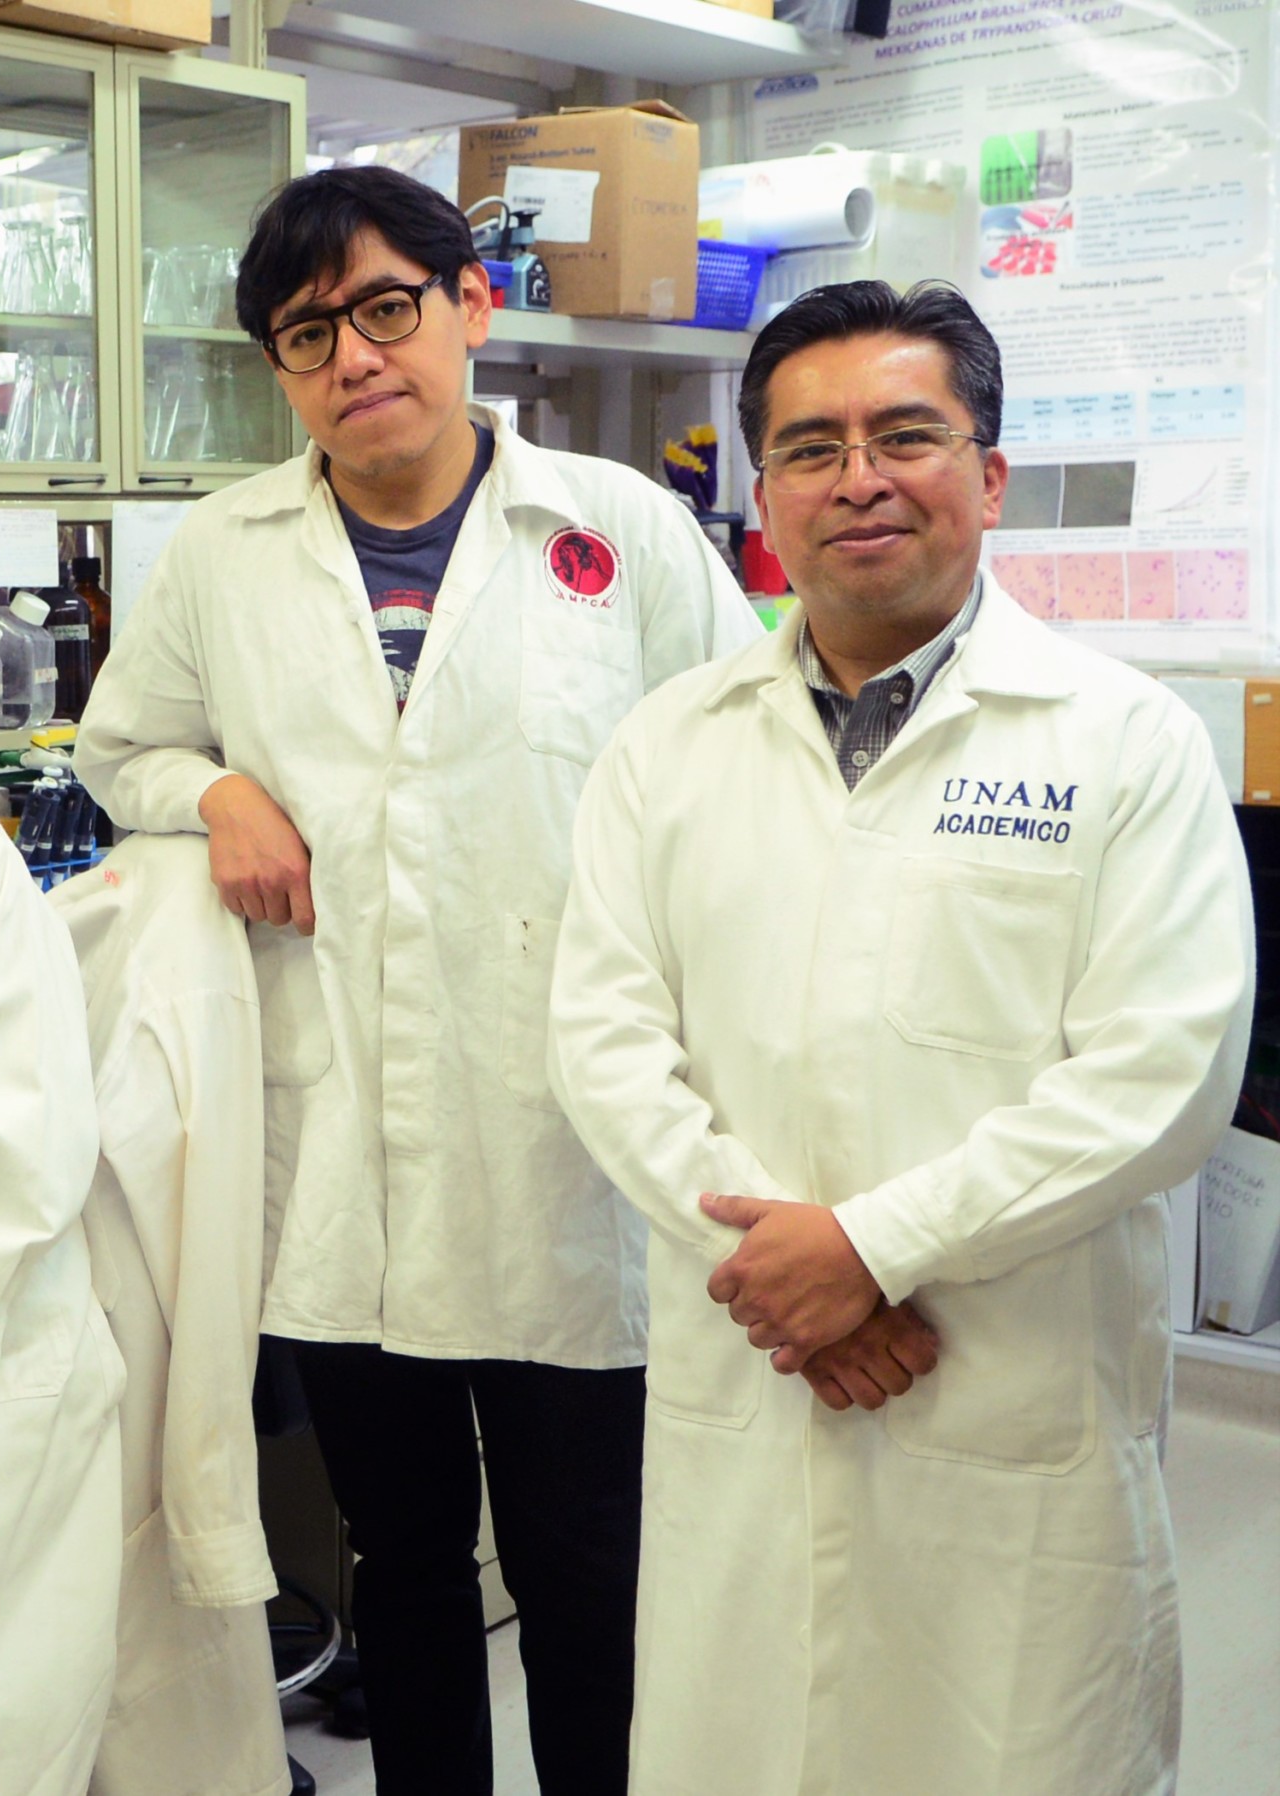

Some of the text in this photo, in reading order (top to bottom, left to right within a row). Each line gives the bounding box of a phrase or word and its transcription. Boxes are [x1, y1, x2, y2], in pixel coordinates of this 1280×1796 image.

[875, 35, 946, 59] MEXICANAS
[950, 31, 966, 45] DE
[1081, 3, 1124, 24] CRUZI
[489, 125, 537, 139] FALCON
[943, 778, 1080, 812] UNAM
[933, 813, 1071, 844] ACADEMICO
